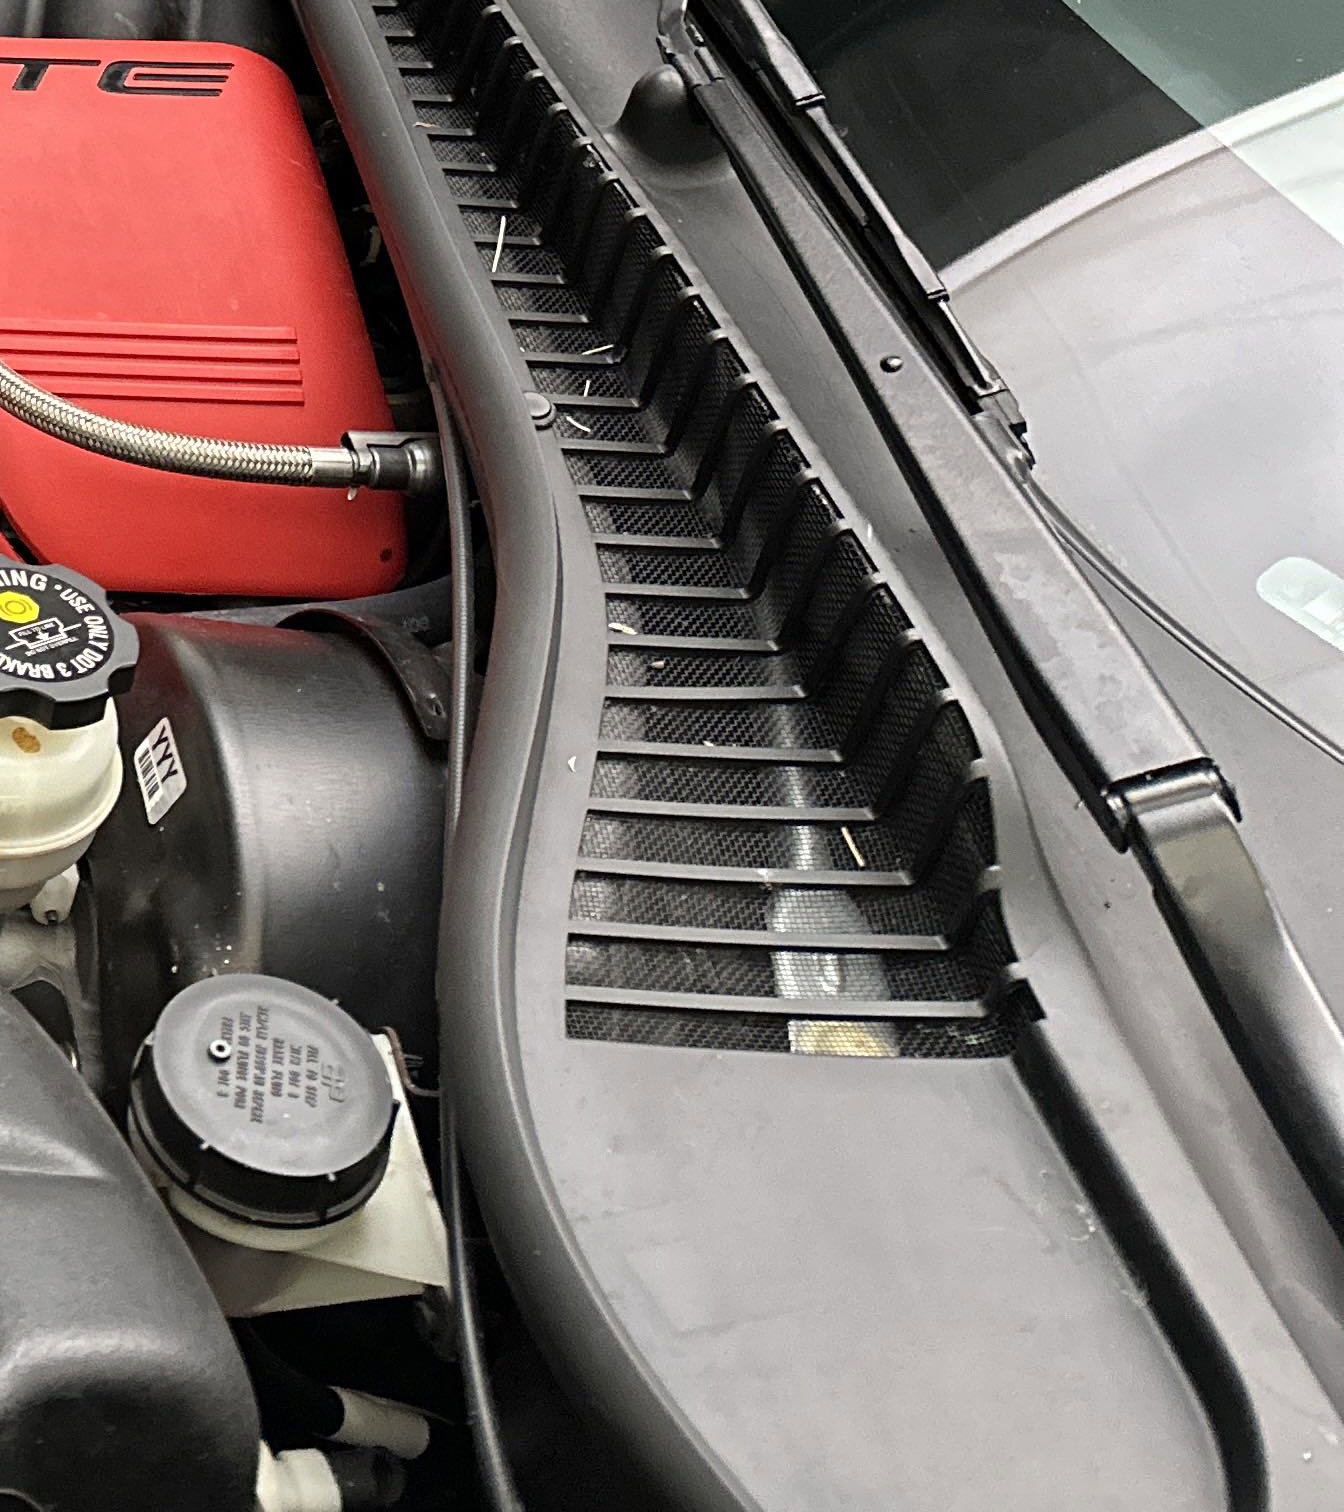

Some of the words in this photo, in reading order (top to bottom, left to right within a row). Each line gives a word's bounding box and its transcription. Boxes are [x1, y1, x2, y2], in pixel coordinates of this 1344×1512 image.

[60, 587, 96, 614] USE
[84, 615, 109, 652] ONLY
[56, 662, 72, 677] 3
[70, 649, 104, 674] DOT
[152, 725, 179, 784] YYY
